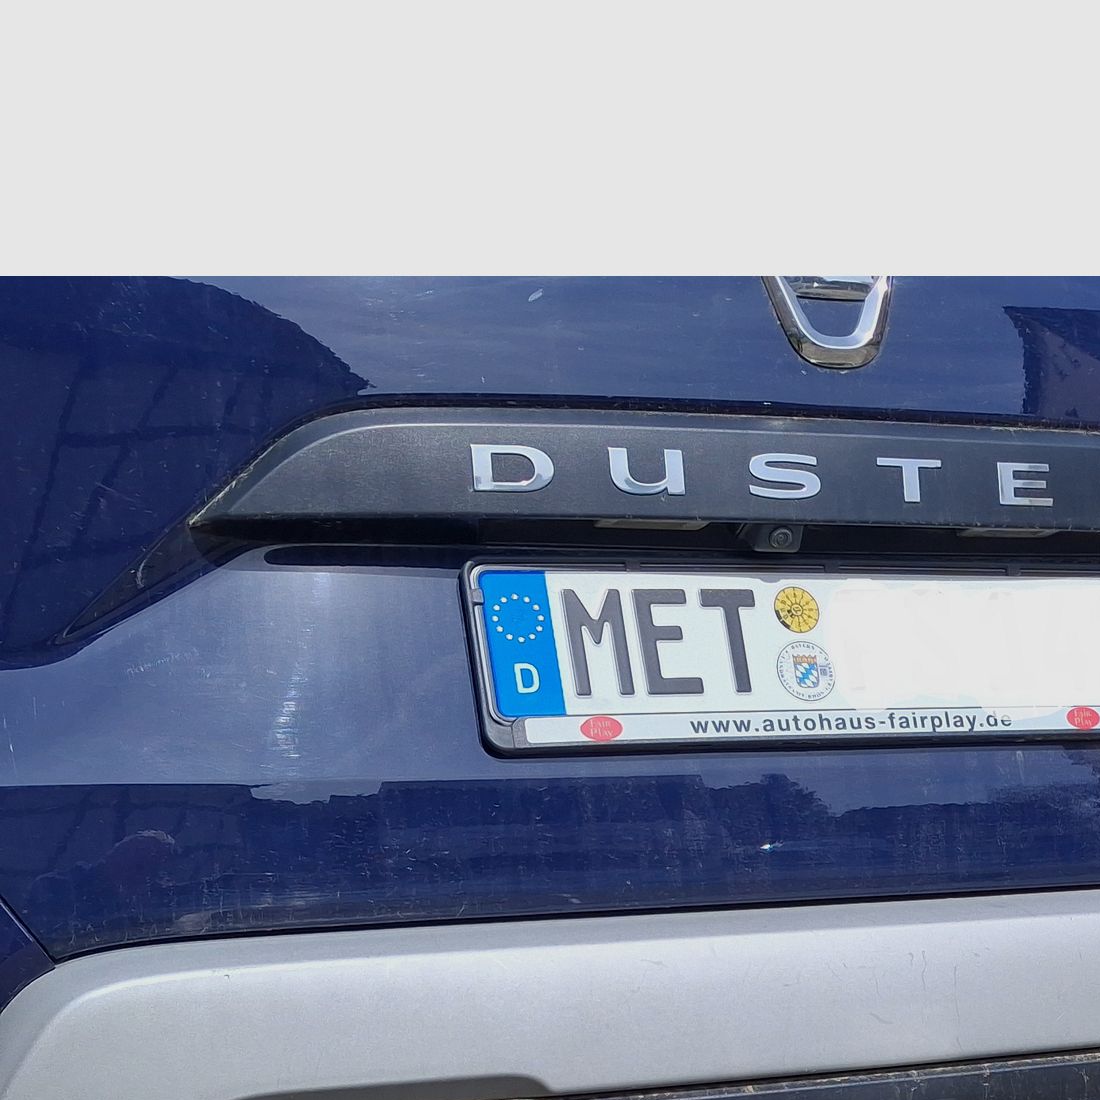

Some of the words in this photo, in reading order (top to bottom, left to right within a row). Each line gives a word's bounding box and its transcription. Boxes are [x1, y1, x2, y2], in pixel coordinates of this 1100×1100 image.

[561, 588, 757, 697] MET
[513, 662, 540, 694] D
[689, 710, 1012, 734] www.autohaus-fairplay.de
